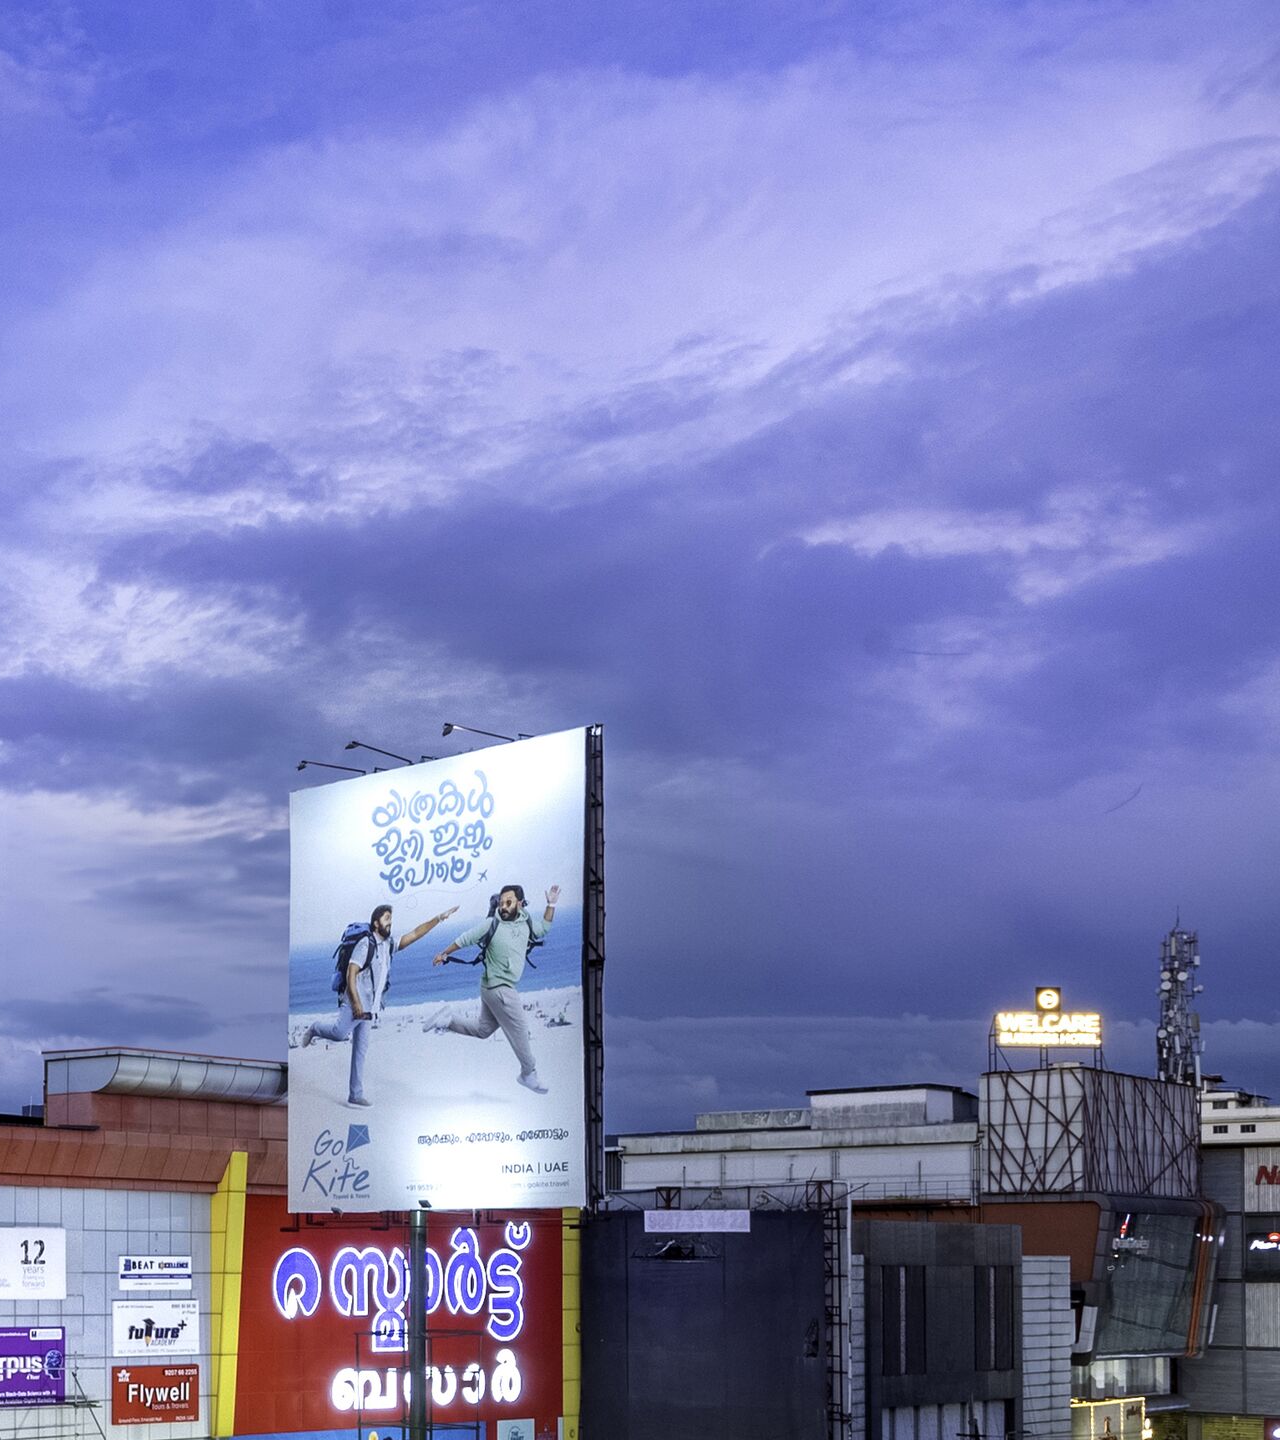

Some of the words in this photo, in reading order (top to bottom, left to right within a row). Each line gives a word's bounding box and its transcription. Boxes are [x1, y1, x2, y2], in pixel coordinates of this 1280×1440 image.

[372, 769, 494, 827] യാത്രകൾ
[371, 827, 424, 865] ഇനി
[997, 1012, 1101, 1033] WELCARE
[999, 1033, 1059, 1046] BUSINESS
[1060, 1033, 1101, 1046] HOTEL
[314, 1129, 344, 1157] Go
[302, 1158, 370, 1197] Kite
[501, 1163, 534, 1174] INDIA
[544, 1161, 569, 1173] UAE
[20, 1240, 46, 1264] 12
[22, 1266, 45, 1274] years
[132, 1260, 155, 1270] BEAT
[128, 1382, 190, 1407] Flywell
